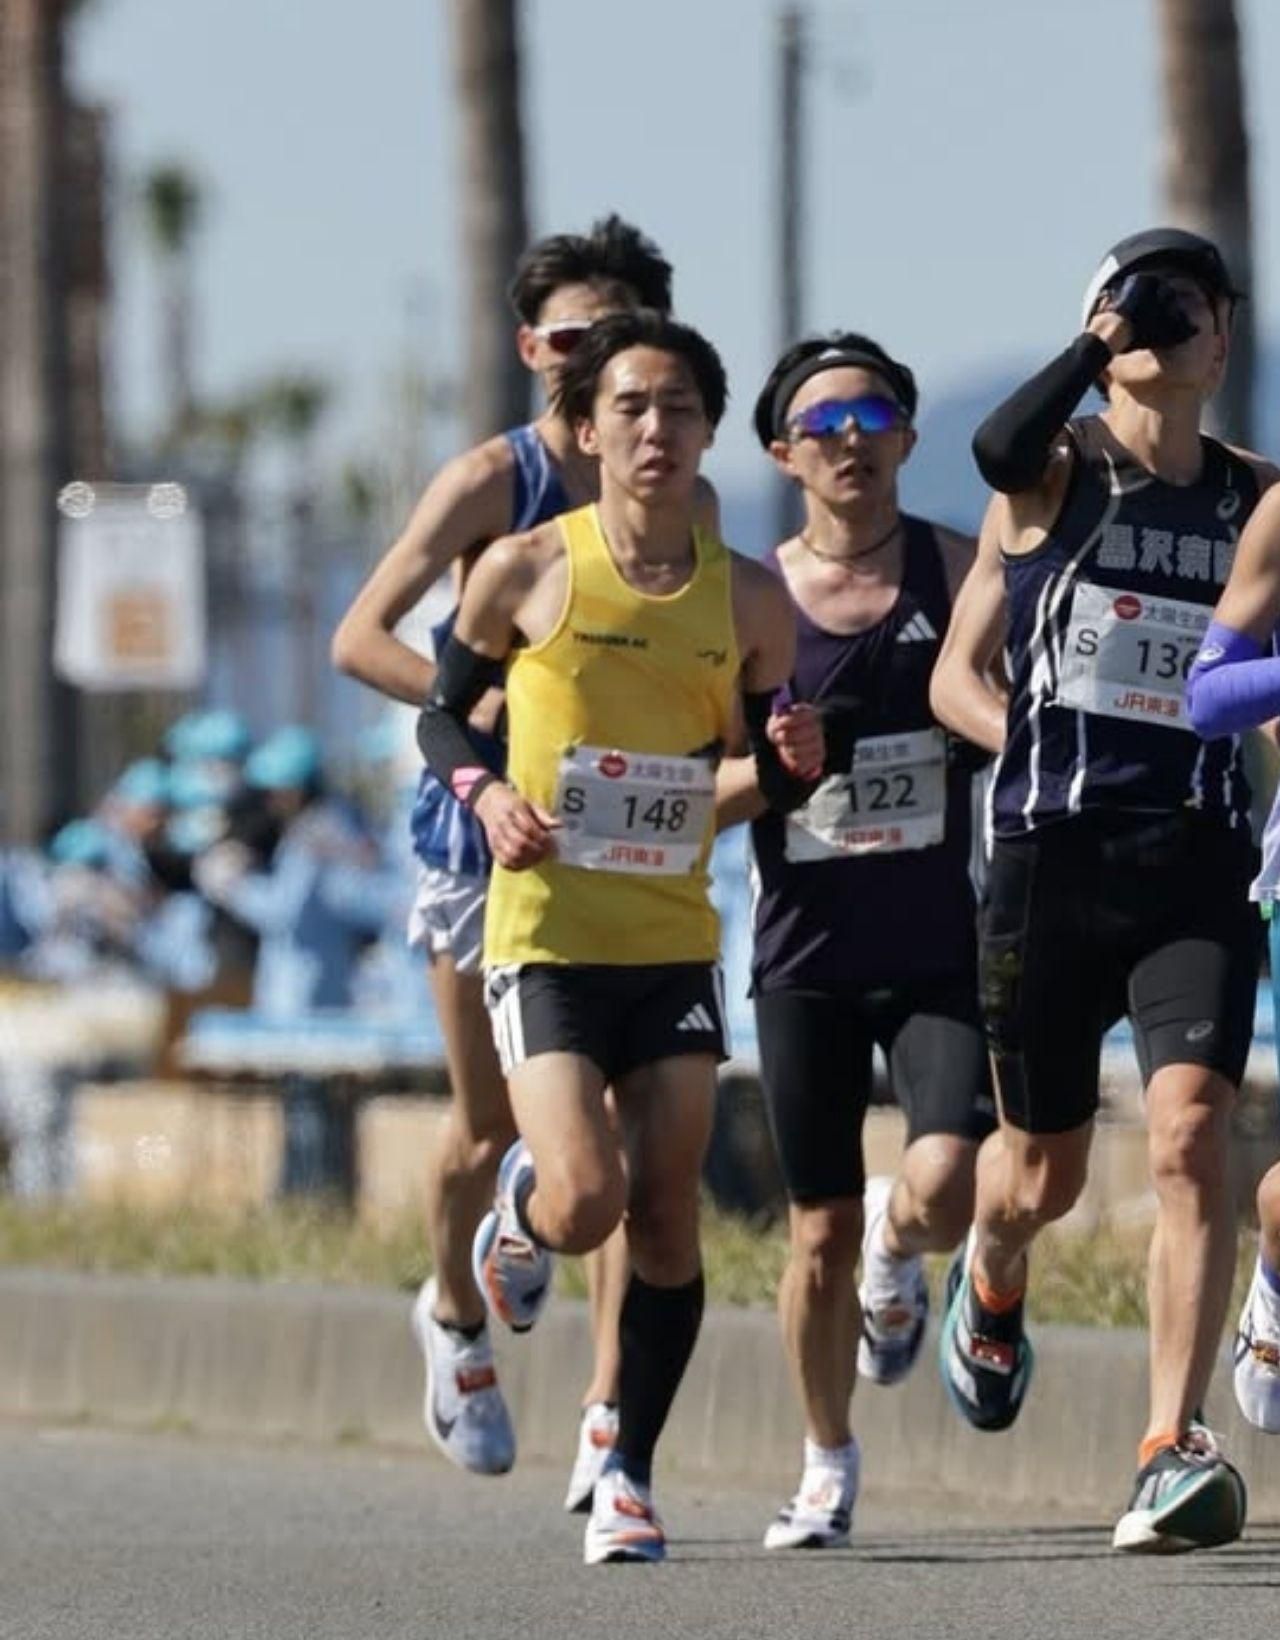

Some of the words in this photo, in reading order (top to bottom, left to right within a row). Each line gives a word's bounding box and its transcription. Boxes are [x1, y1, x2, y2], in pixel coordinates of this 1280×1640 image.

[1076, 628, 1098, 656] S
[563, 787, 586, 814] S
[622, 795, 689, 833] 148
[843, 773, 918, 813] 122
